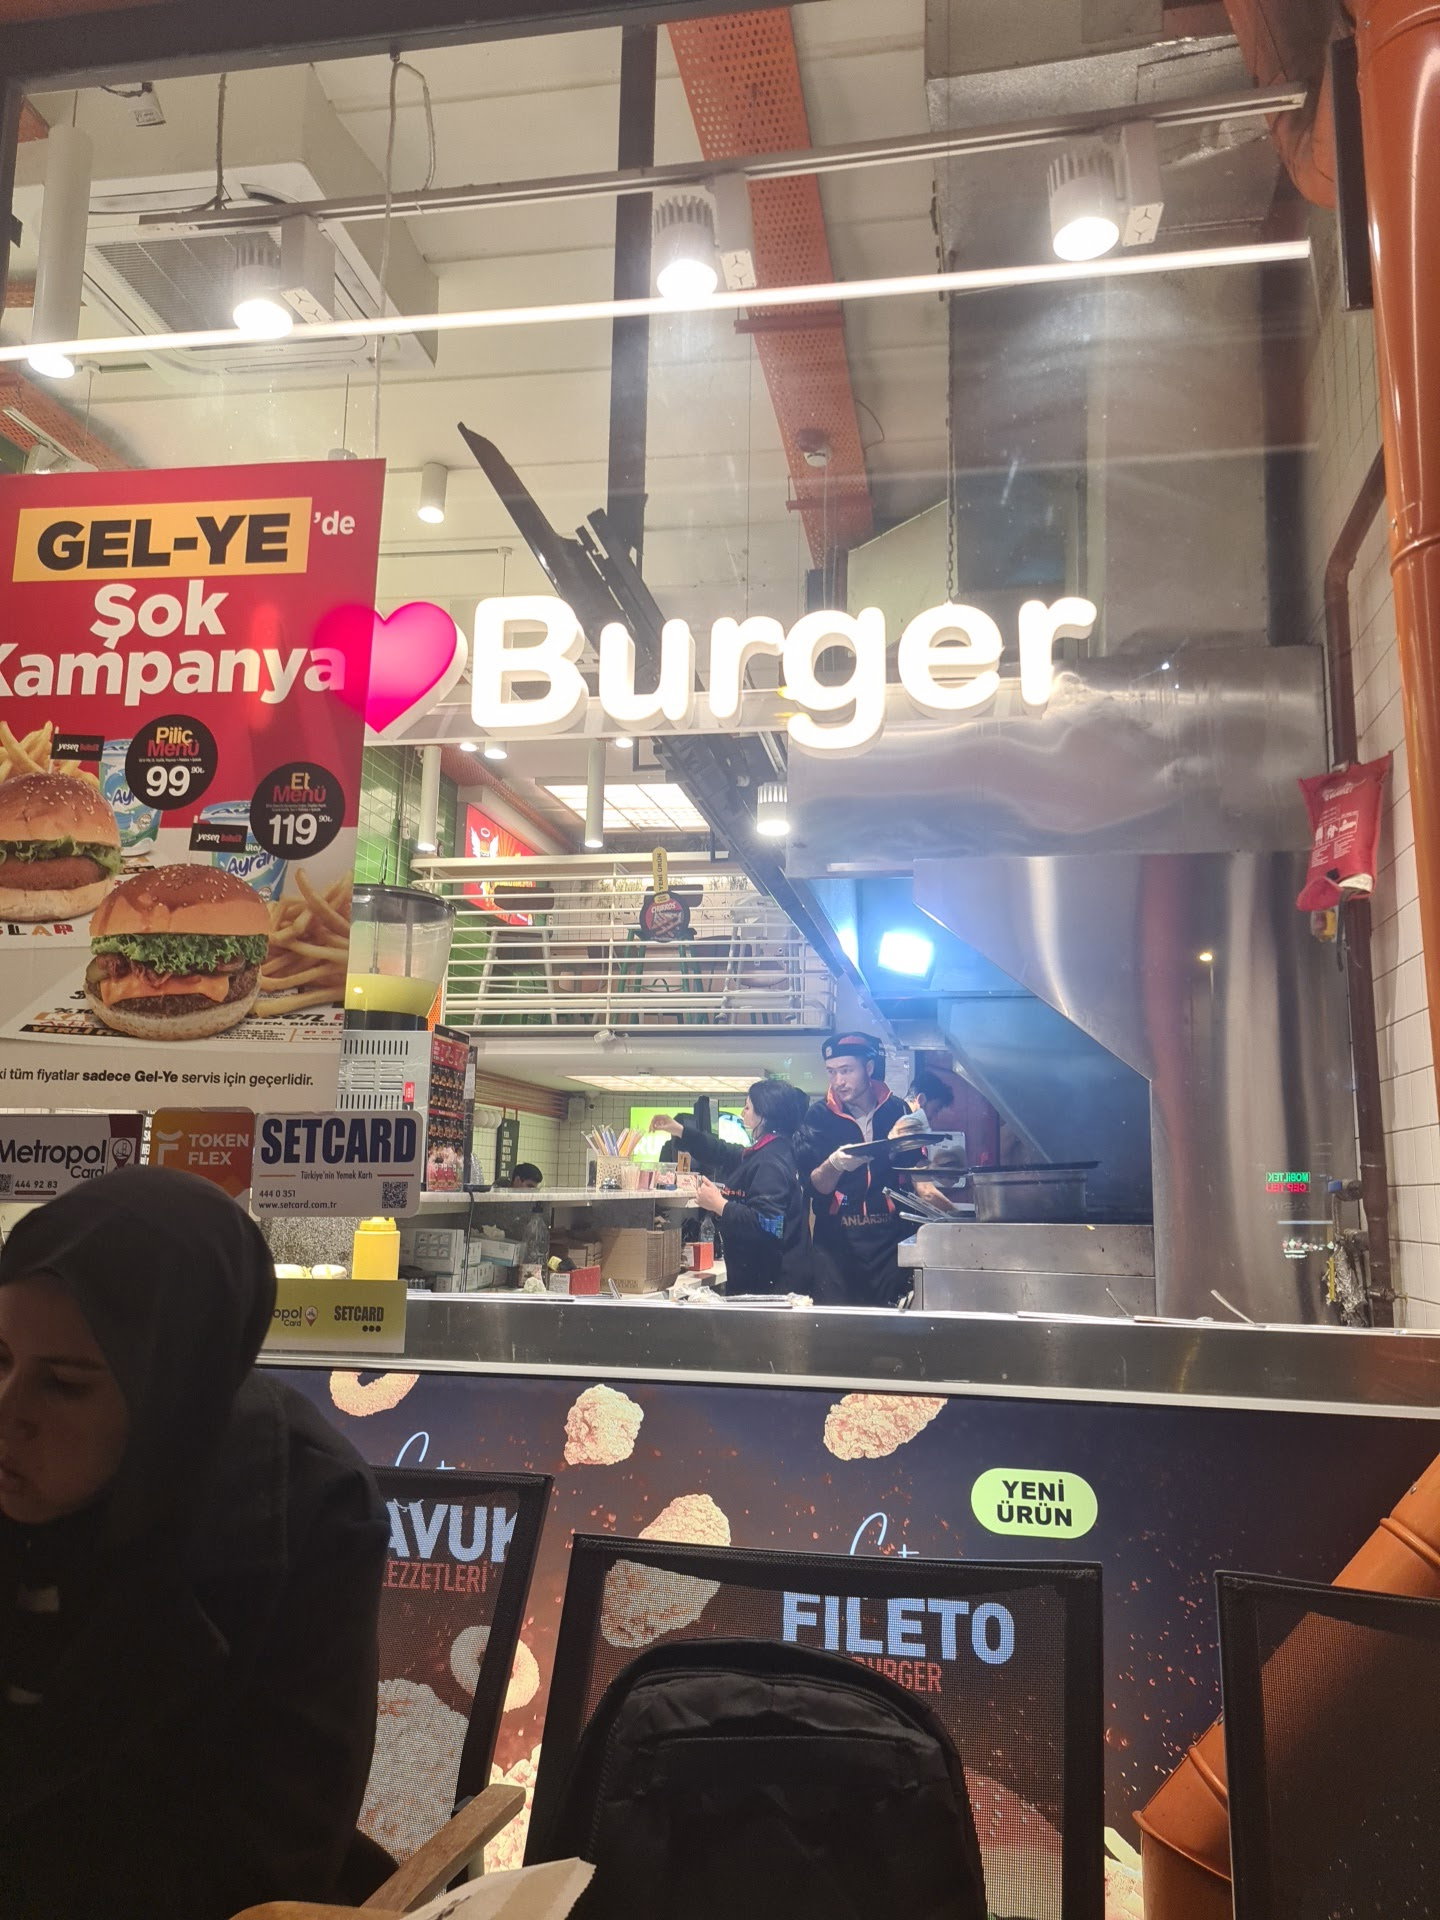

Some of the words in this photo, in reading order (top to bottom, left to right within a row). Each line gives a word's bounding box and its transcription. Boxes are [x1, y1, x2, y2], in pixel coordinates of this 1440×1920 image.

[37, 512, 291, 571] GEL-YE
[90, 579, 229, 650] Şok
[470, 595, 1097, 756] Burger
[146, 765, 191, 797] 99
[290, 772, 310, 790] Et
[269, 813, 318, 845] 119
[10, 1069, 34, 1081] tüm
[37, 1069, 79, 1083] fiyatlar
[82, 1070, 131, 1082] sadece
[135, 1070, 178, 1083] Gel-Ye
[181, 1072, 221, 1084] servis
[223, 1072, 246, 1087] için
[249, 1073, 314, 1088] geçerlidir.
[189, 1133, 249, 1148] TOKEN
[260, 1117, 417, 1165] SETCARD
[188, 1151, 232, 1166] FLEX
[70, 1165, 105, 1179] Card
[300, 1170, 335, 1181] Türkiye'nin
[336, 1170, 357, 1180] Yemek
[34, 1180, 44, 1188] 92
[47, 1180, 58, 1188] 83
[259, 1190, 274, 1198] 444
[275, 1190, 281, 1198] 0
[283, 1190, 296, 1198] 351
[258, 1201, 337, 1209] www.setcard.com.tr
[334, 1306, 384, 1322] SETCARD
[1002, 1479, 1065, 1502] YENİ
[996, 1500, 1072, 1527] ÜRÜN
